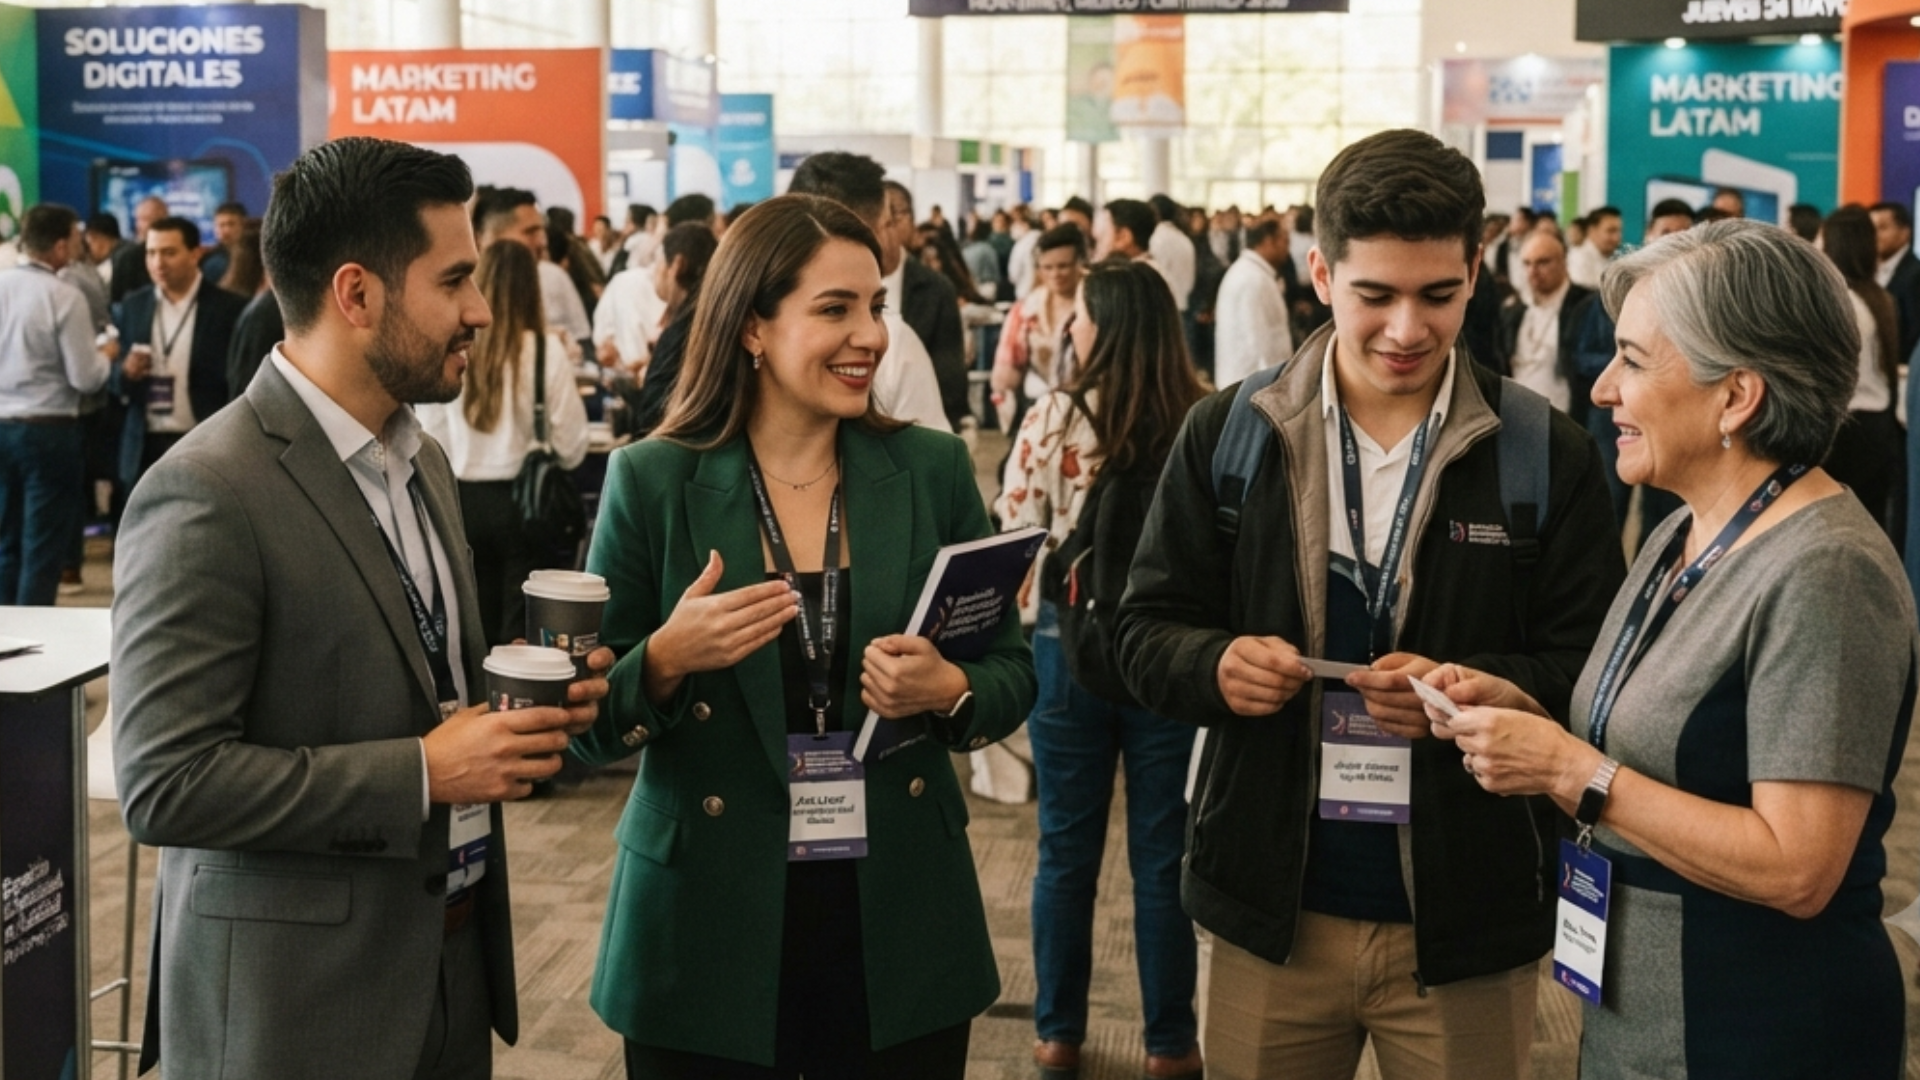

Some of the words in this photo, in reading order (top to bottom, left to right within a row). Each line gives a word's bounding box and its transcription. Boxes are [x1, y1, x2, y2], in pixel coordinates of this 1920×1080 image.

[64, 26, 265, 56] SOLUCIONES
[83, 59, 243, 89] DIGITALES
[351, 62, 536, 92] MARKETING
[351, 95, 457, 124] LATAM
[1650, 106, 1762, 137] LATAM
